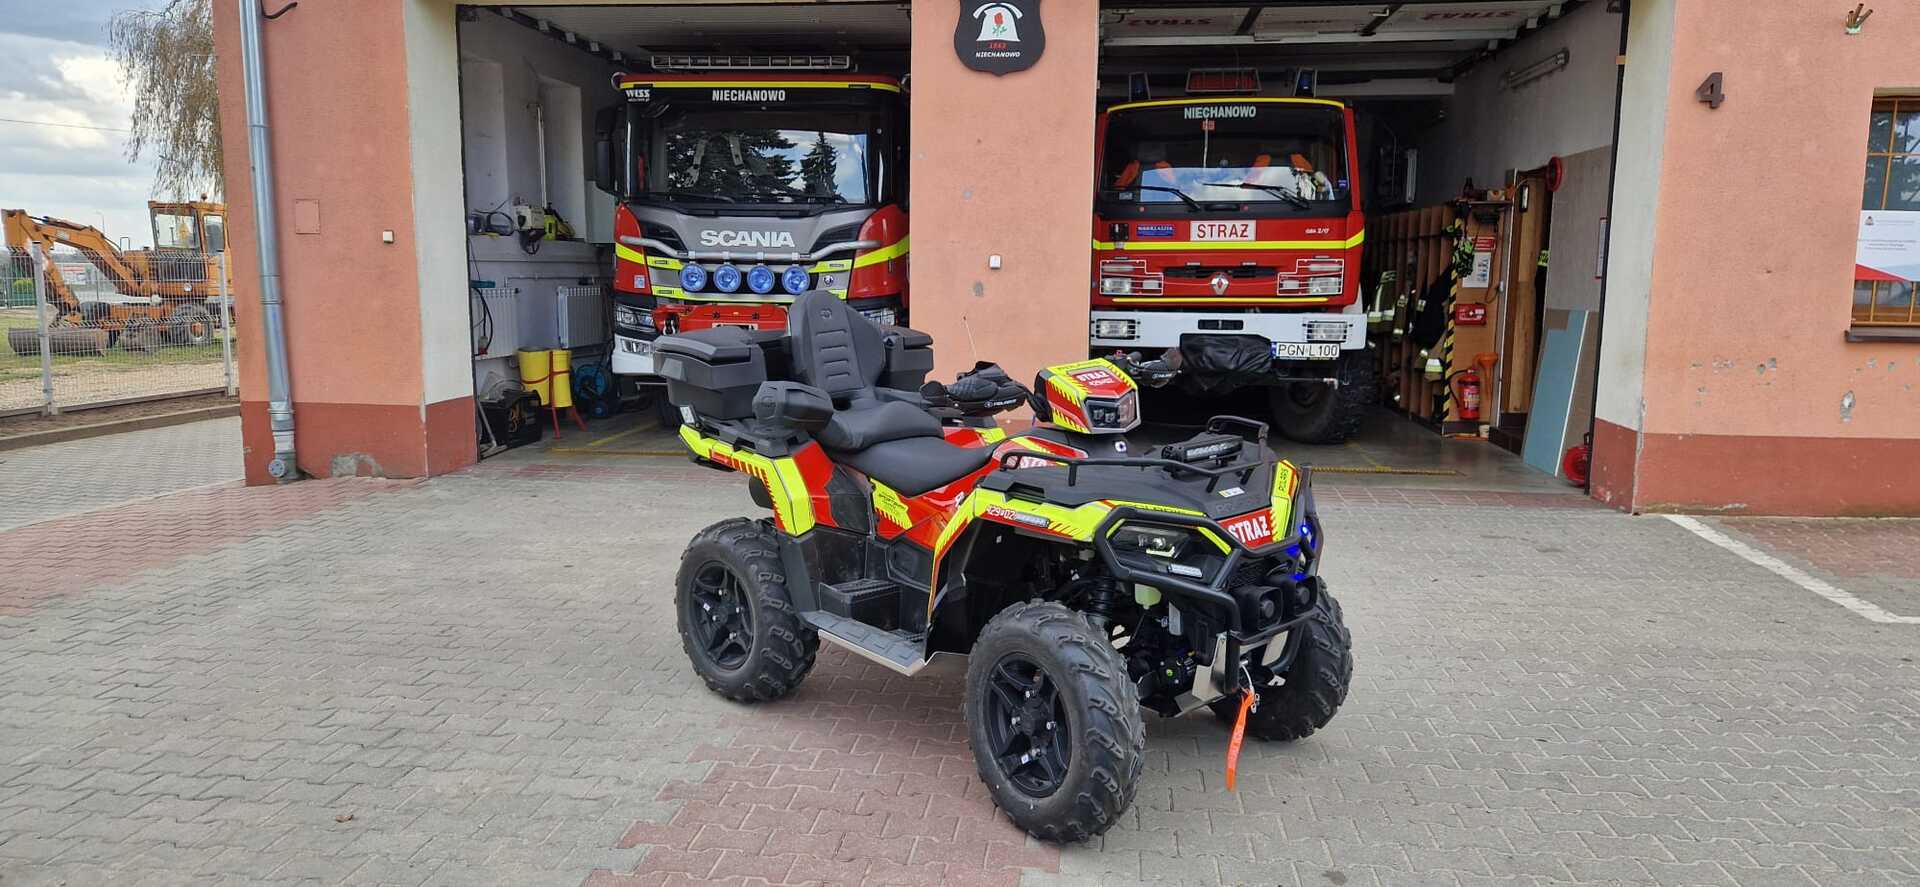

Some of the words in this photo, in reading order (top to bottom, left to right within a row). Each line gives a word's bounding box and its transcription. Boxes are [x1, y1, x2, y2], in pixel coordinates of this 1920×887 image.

[625, 89, 650, 98] WISS
[712, 89, 786, 102] NIECHANOWO
[1695, 71, 1725, 109] 4
[1184, 105, 1256, 119] NIECHANOWO
[700, 229, 796, 248] SCANIA
[1278, 344, 1305, 357] PGN
